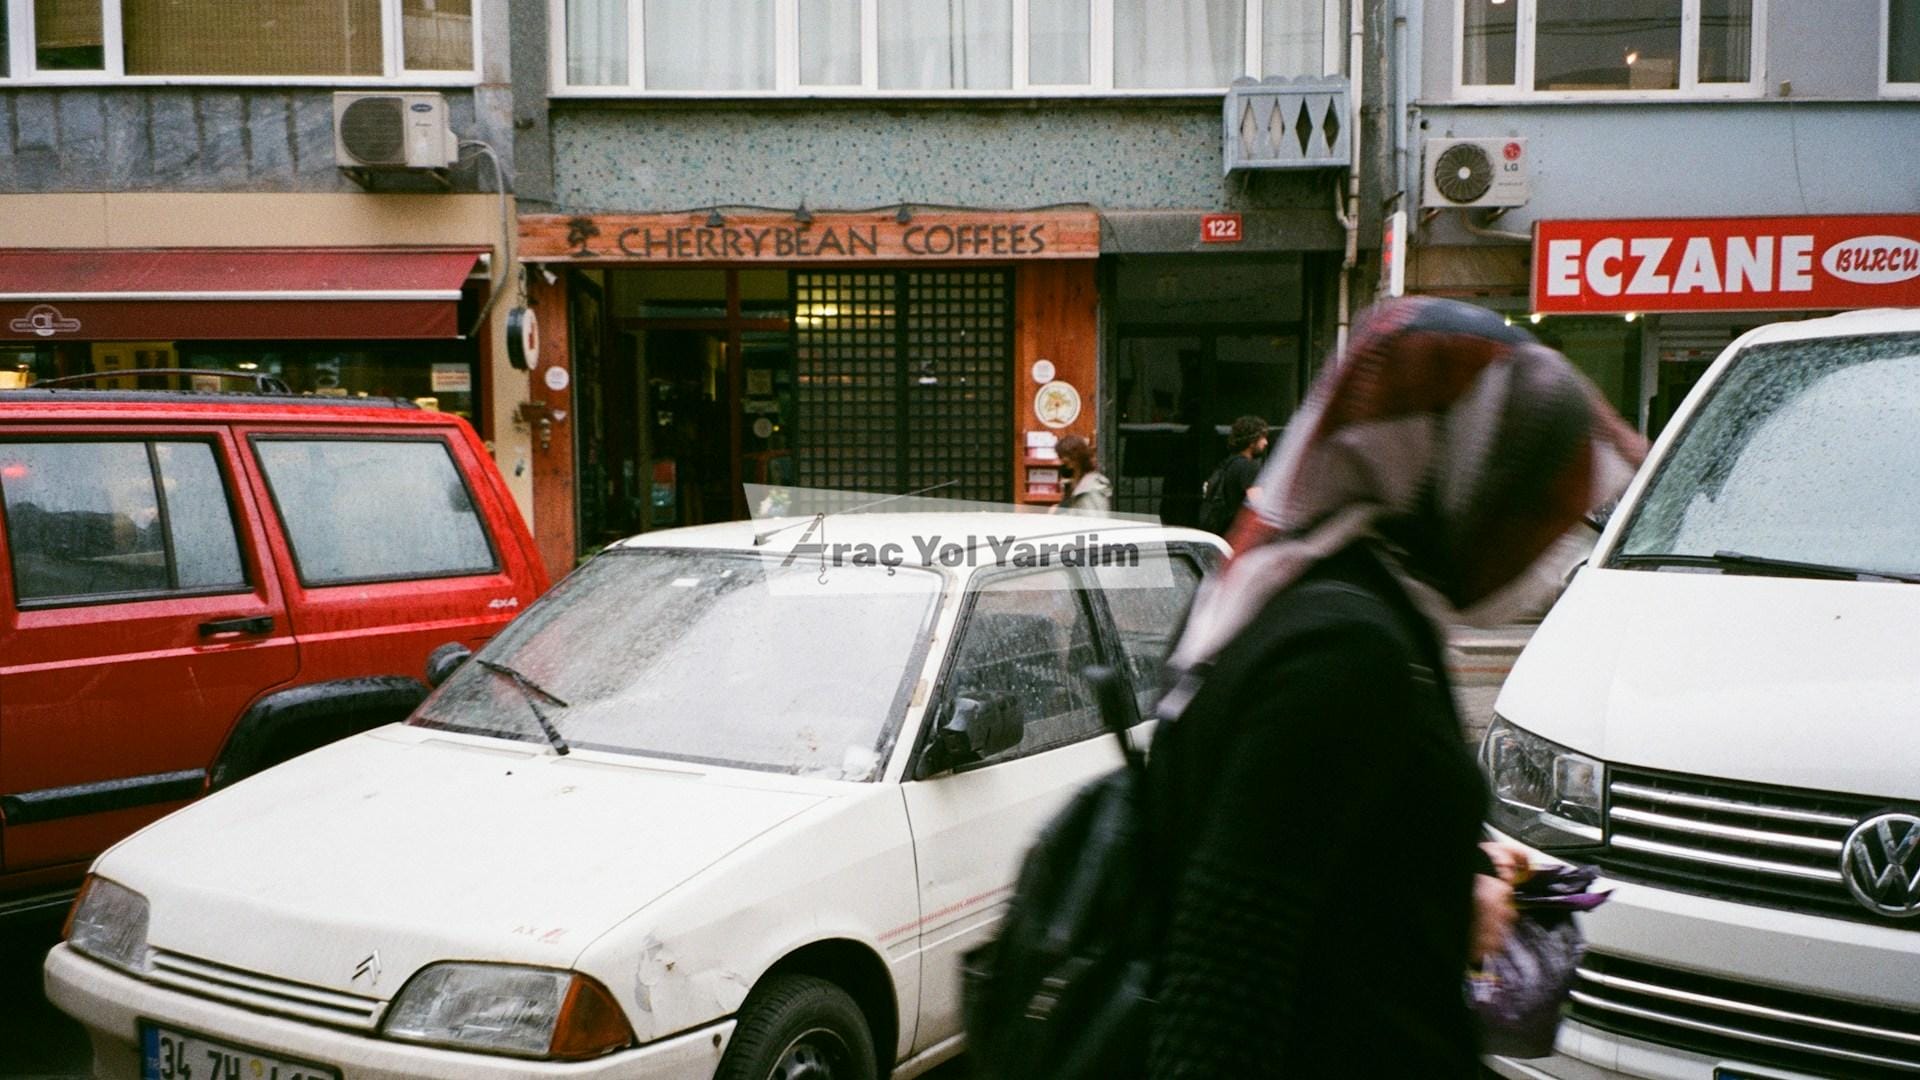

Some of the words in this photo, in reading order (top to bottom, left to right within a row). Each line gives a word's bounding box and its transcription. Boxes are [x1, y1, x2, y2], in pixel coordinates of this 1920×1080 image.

[1504, 162, 1519, 171] LG
[618, 225, 878, 257] CHERRYBEAN
[903, 224, 1045, 255] COFFEES
[1207, 219, 1237, 237] 122
[1547, 235, 1815, 297] ECZANE
[1836, 247, 1919, 272] BURCU
[160, 1036, 192, 1080] 34
